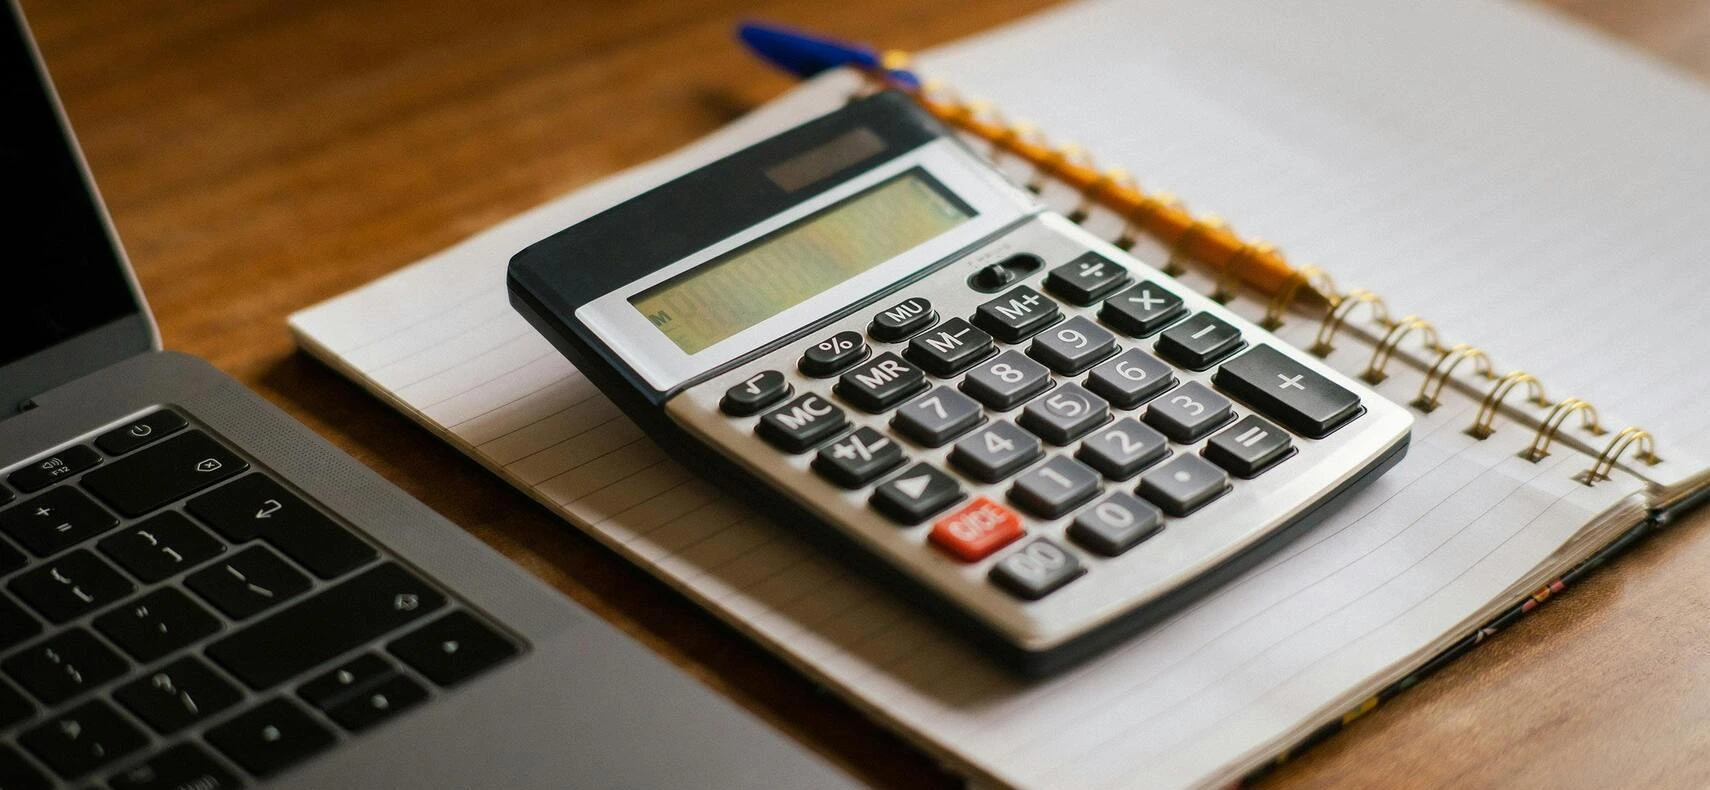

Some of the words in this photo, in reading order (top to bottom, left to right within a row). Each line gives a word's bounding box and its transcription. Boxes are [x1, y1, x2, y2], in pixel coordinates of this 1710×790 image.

[885, 300, 923, 323] MU
[994, 294, 1039, 319] M+
[649, 311, 672, 326] M
[819, 337, 852, 354] %
[1057, 329, 1087, 348] 9
[855, 360, 909, 388] MR
[991, 363, 1023, 382] 8
[1116, 361, 1146, 380] 6
[776, 397, 832, 430] MC
[920, 397, 947, 418] 7
[1047, 394, 1081, 416] 5
[1171, 395, 1204, 416] 3
[985, 432, 1014, 453] 4
[1105, 430, 1143, 454] 2
[52, 465, 70, 477] F12
[1039, 468, 1072, 487] 1
[1096, 502, 1134, 528] 0
[1004, 540, 1065, 588] 00
